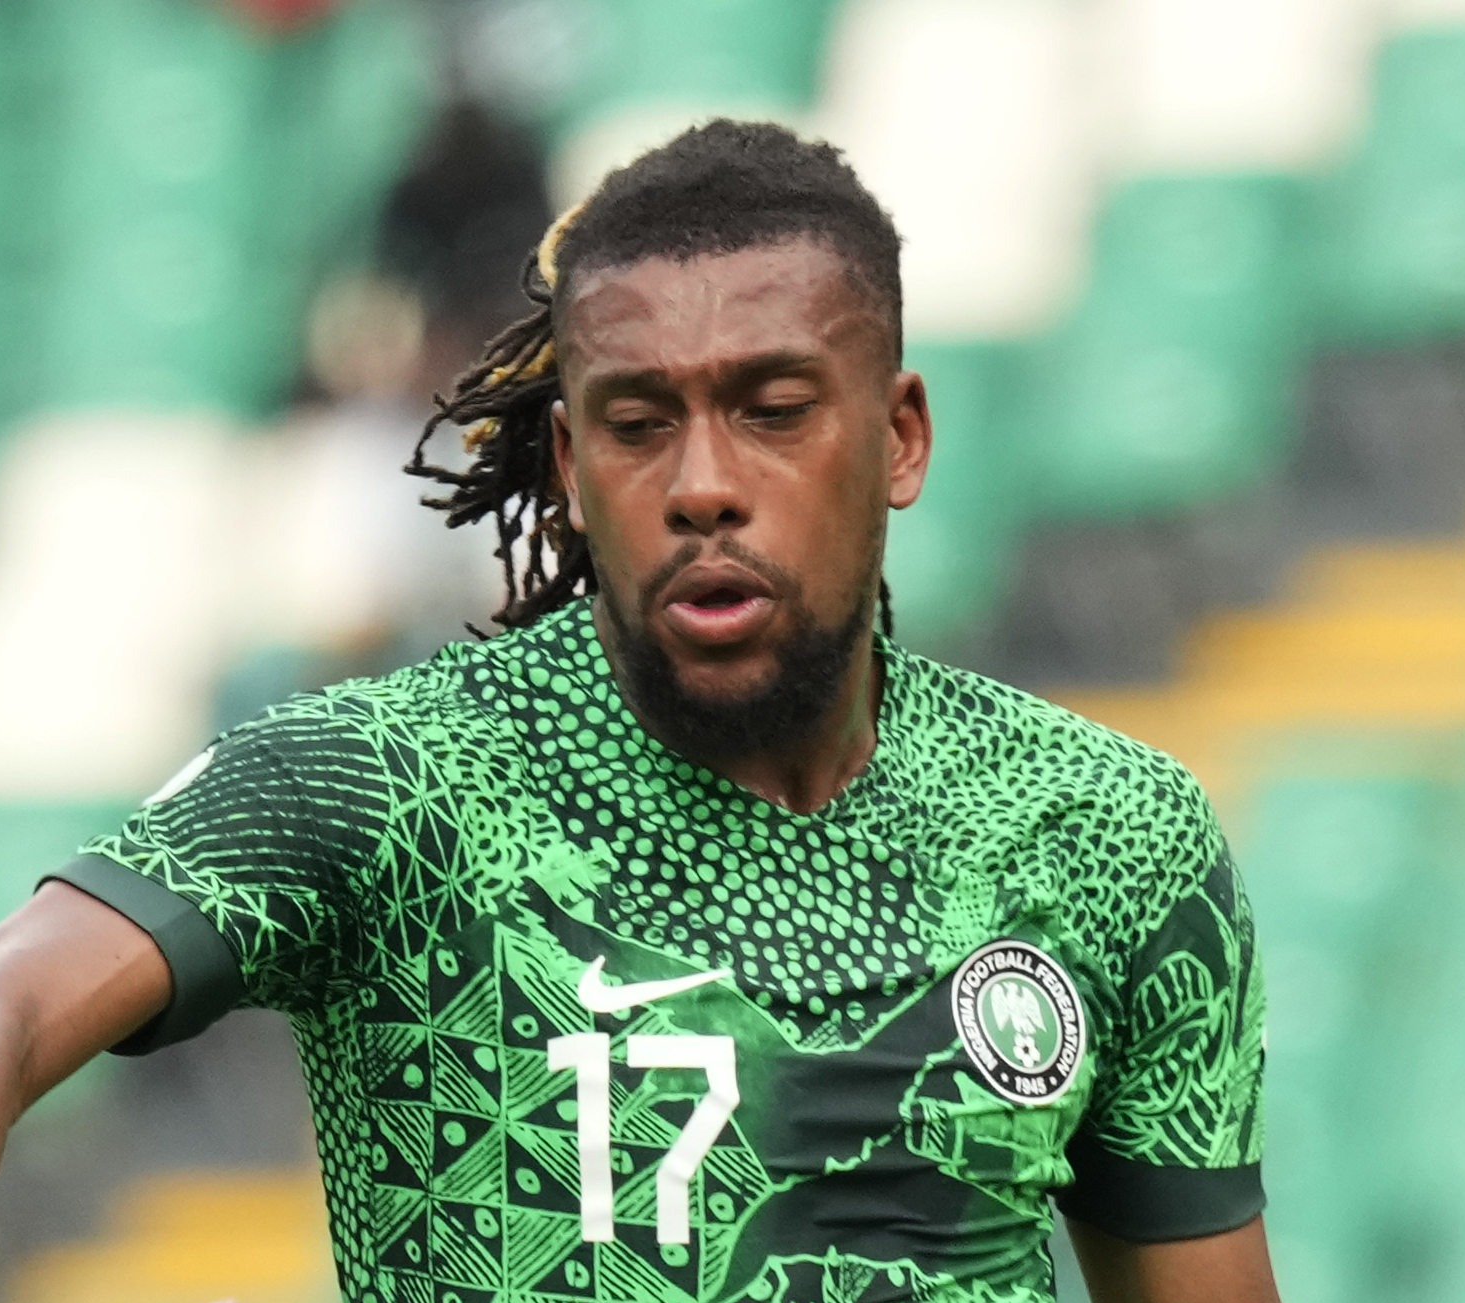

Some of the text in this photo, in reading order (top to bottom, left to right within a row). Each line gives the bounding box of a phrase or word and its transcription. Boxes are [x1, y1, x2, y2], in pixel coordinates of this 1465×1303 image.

[959, 950, 1079, 1077] NIGERIA FOOTBALL FEDERATION
[547, 1032, 740, 1244] 17
[1014, 1076, 1048, 1095] 1945
